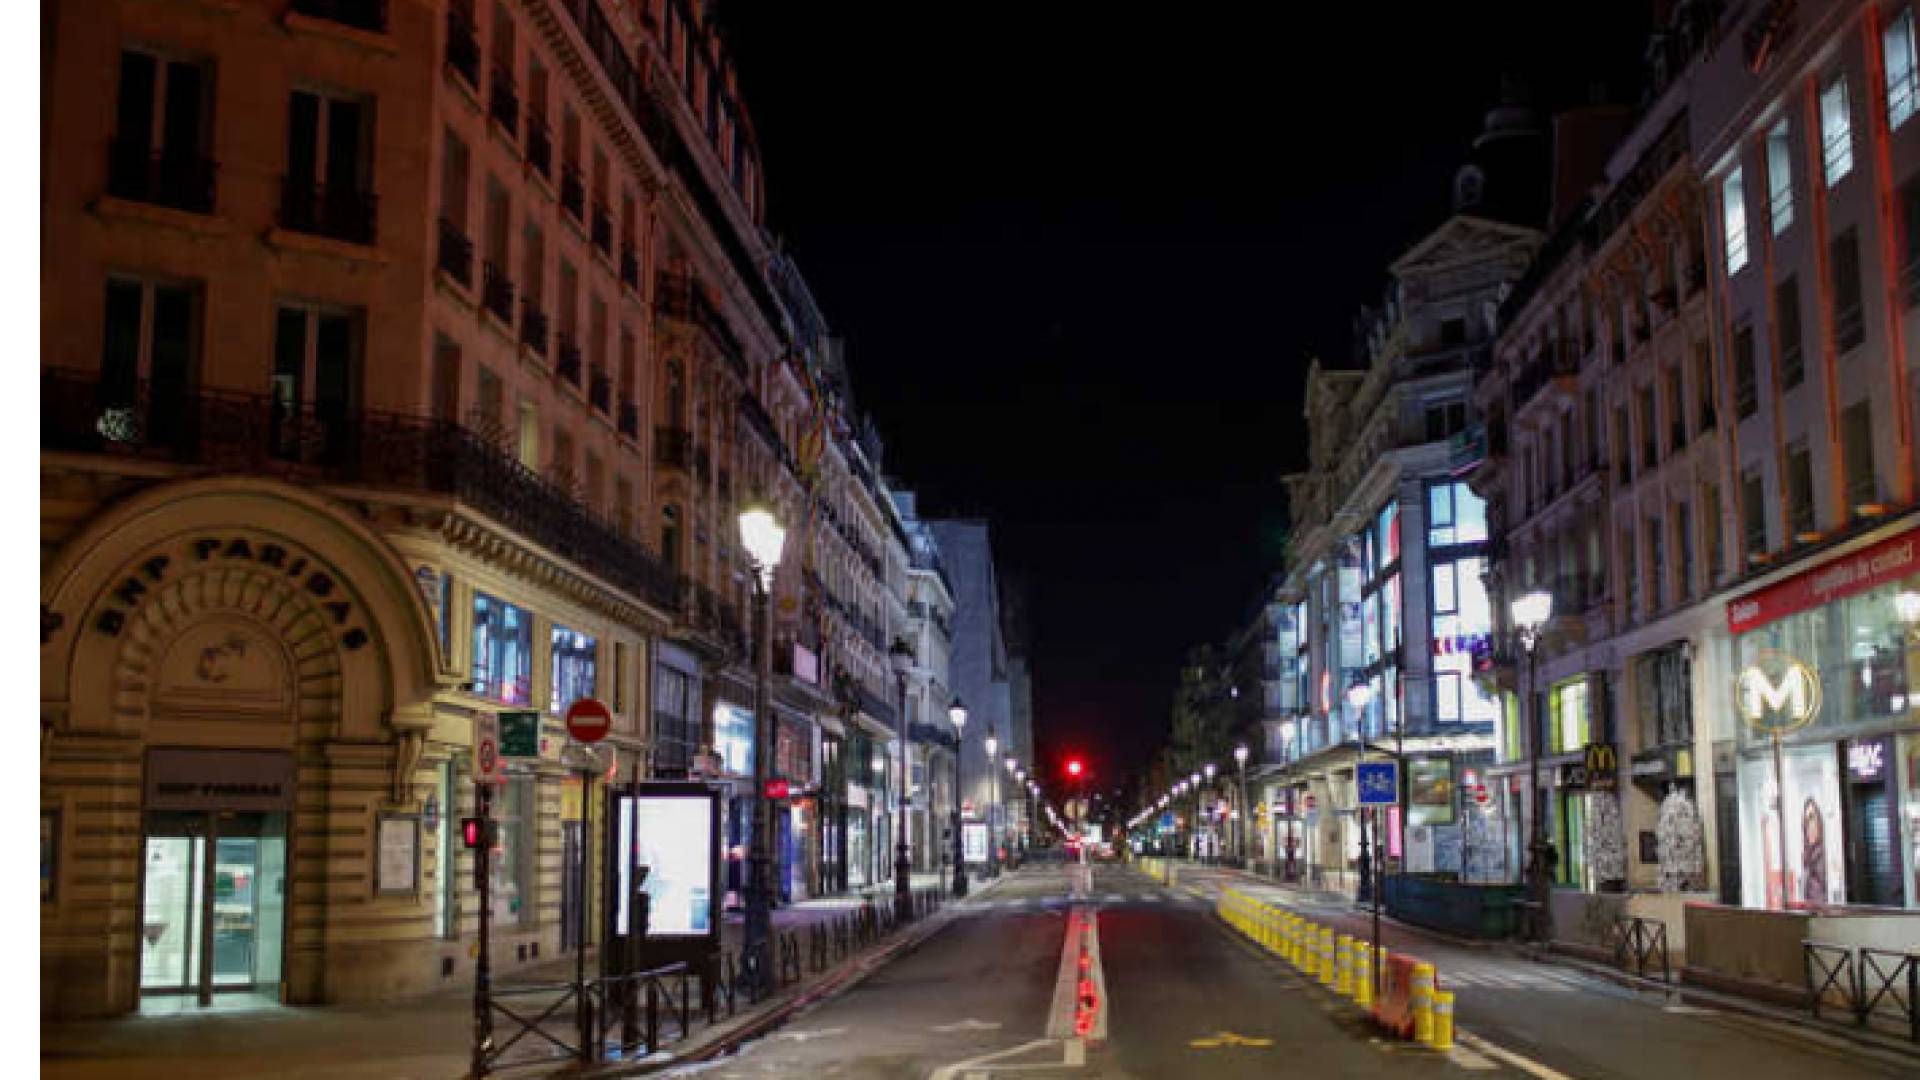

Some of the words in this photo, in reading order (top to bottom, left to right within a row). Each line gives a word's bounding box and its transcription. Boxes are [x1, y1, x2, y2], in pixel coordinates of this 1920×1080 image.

[95, 555, 170, 637] BNP
[194, 538, 368, 650] PARIBAS
[1742, 665, 1809, 719] M
